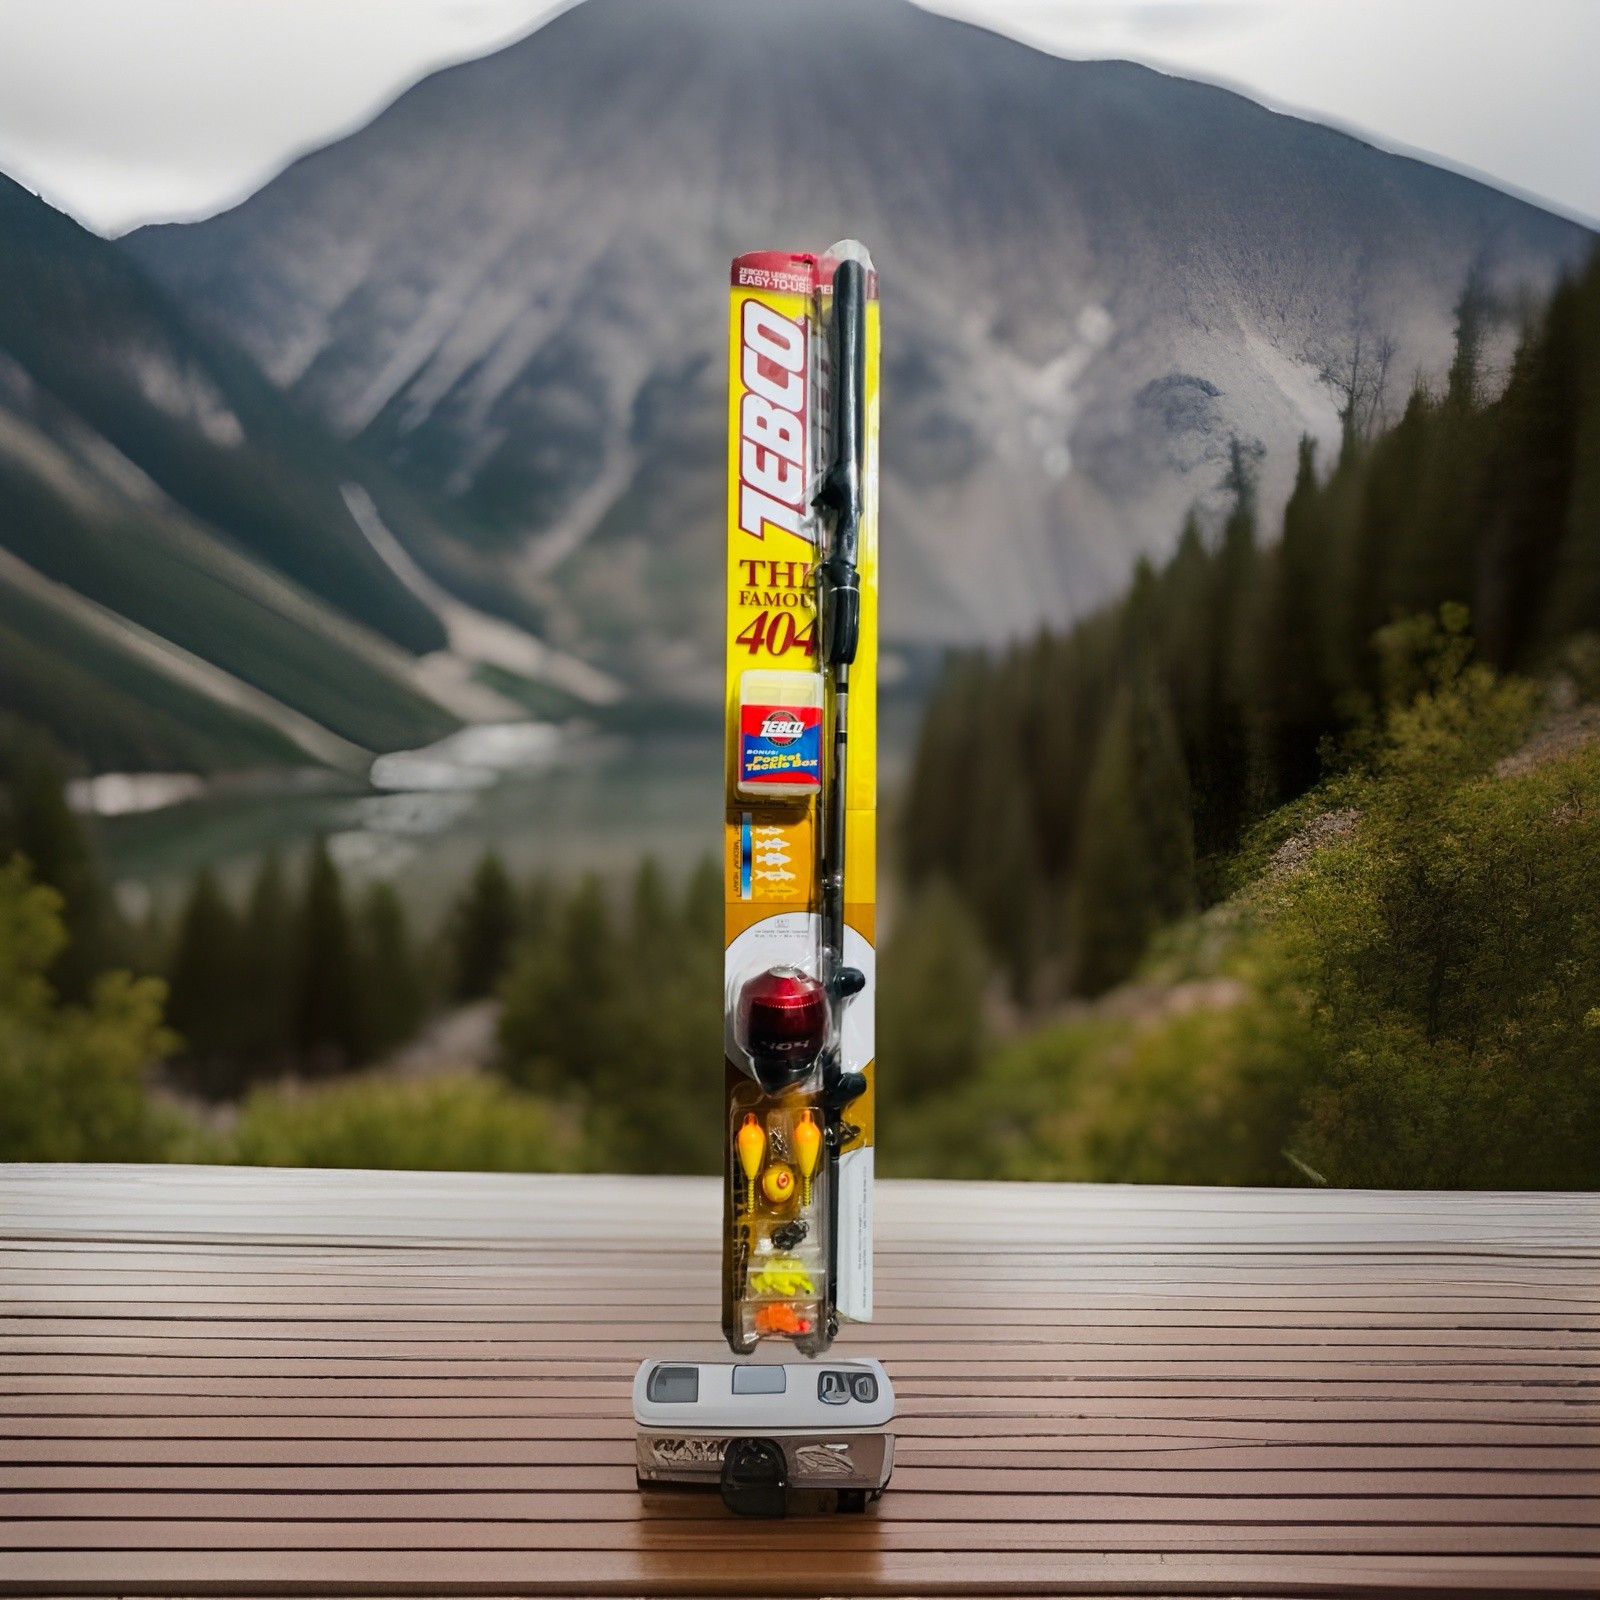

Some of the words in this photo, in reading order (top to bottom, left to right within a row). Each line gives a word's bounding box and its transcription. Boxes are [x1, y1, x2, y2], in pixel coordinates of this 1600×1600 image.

[739, 274, 812, 293] EASY-TO-USE
[739, 298, 814, 543] ZEBCO
[739, 590, 816, 609] FAMOU
[735, 610, 817, 657] 404
[760, 720, 805, 738] ZEBCO
[745, 760, 790, 771] Tackle
[792, 759, 819, 768] Box
[753, 753, 801, 763] Pocket
